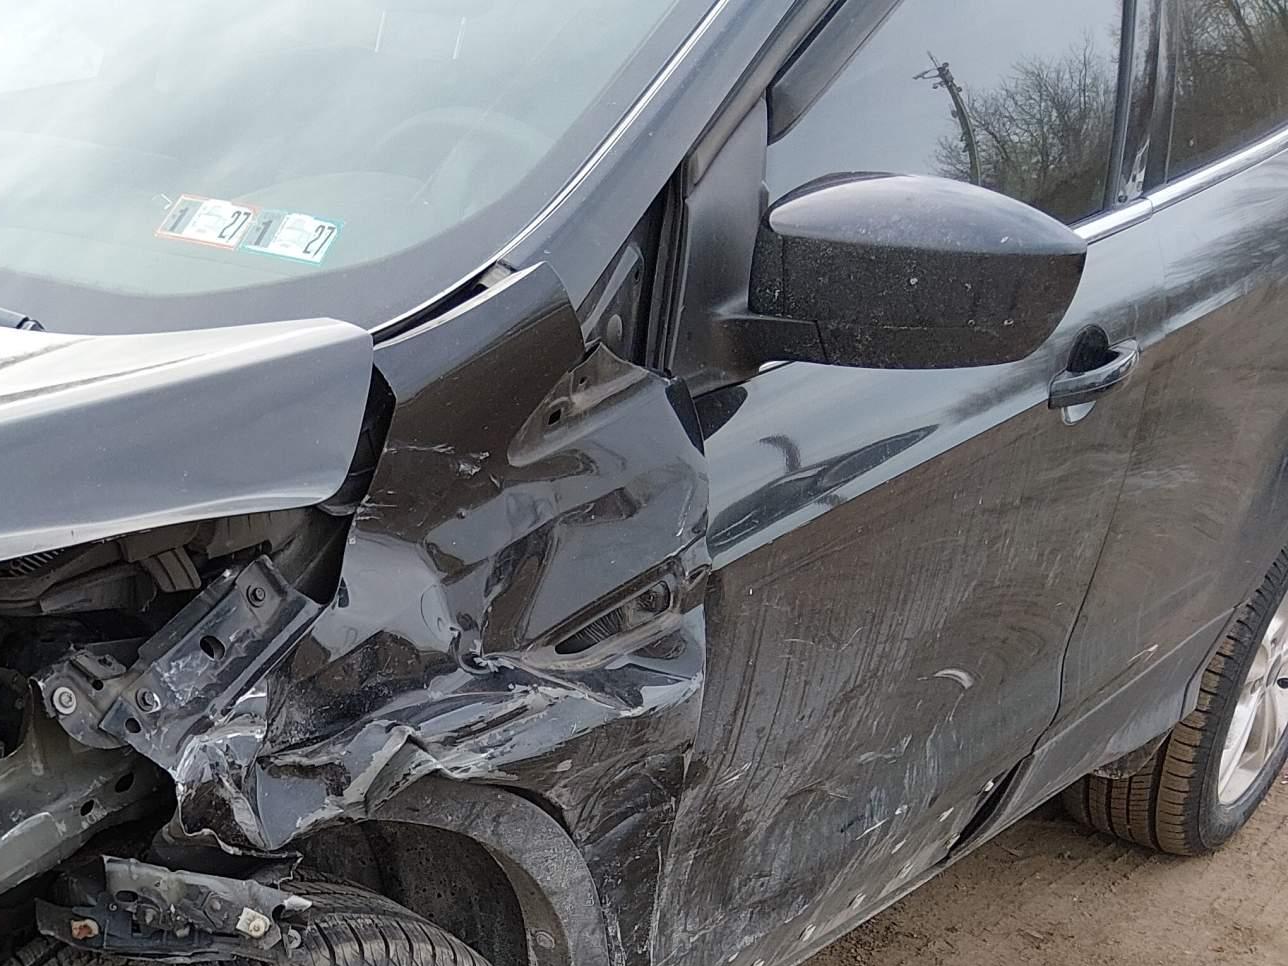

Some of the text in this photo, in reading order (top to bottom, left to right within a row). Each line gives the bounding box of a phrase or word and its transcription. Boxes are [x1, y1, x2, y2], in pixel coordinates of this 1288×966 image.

[169, 206, 252, 241] 1 27
[254, 219, 336, 258] 1 27
